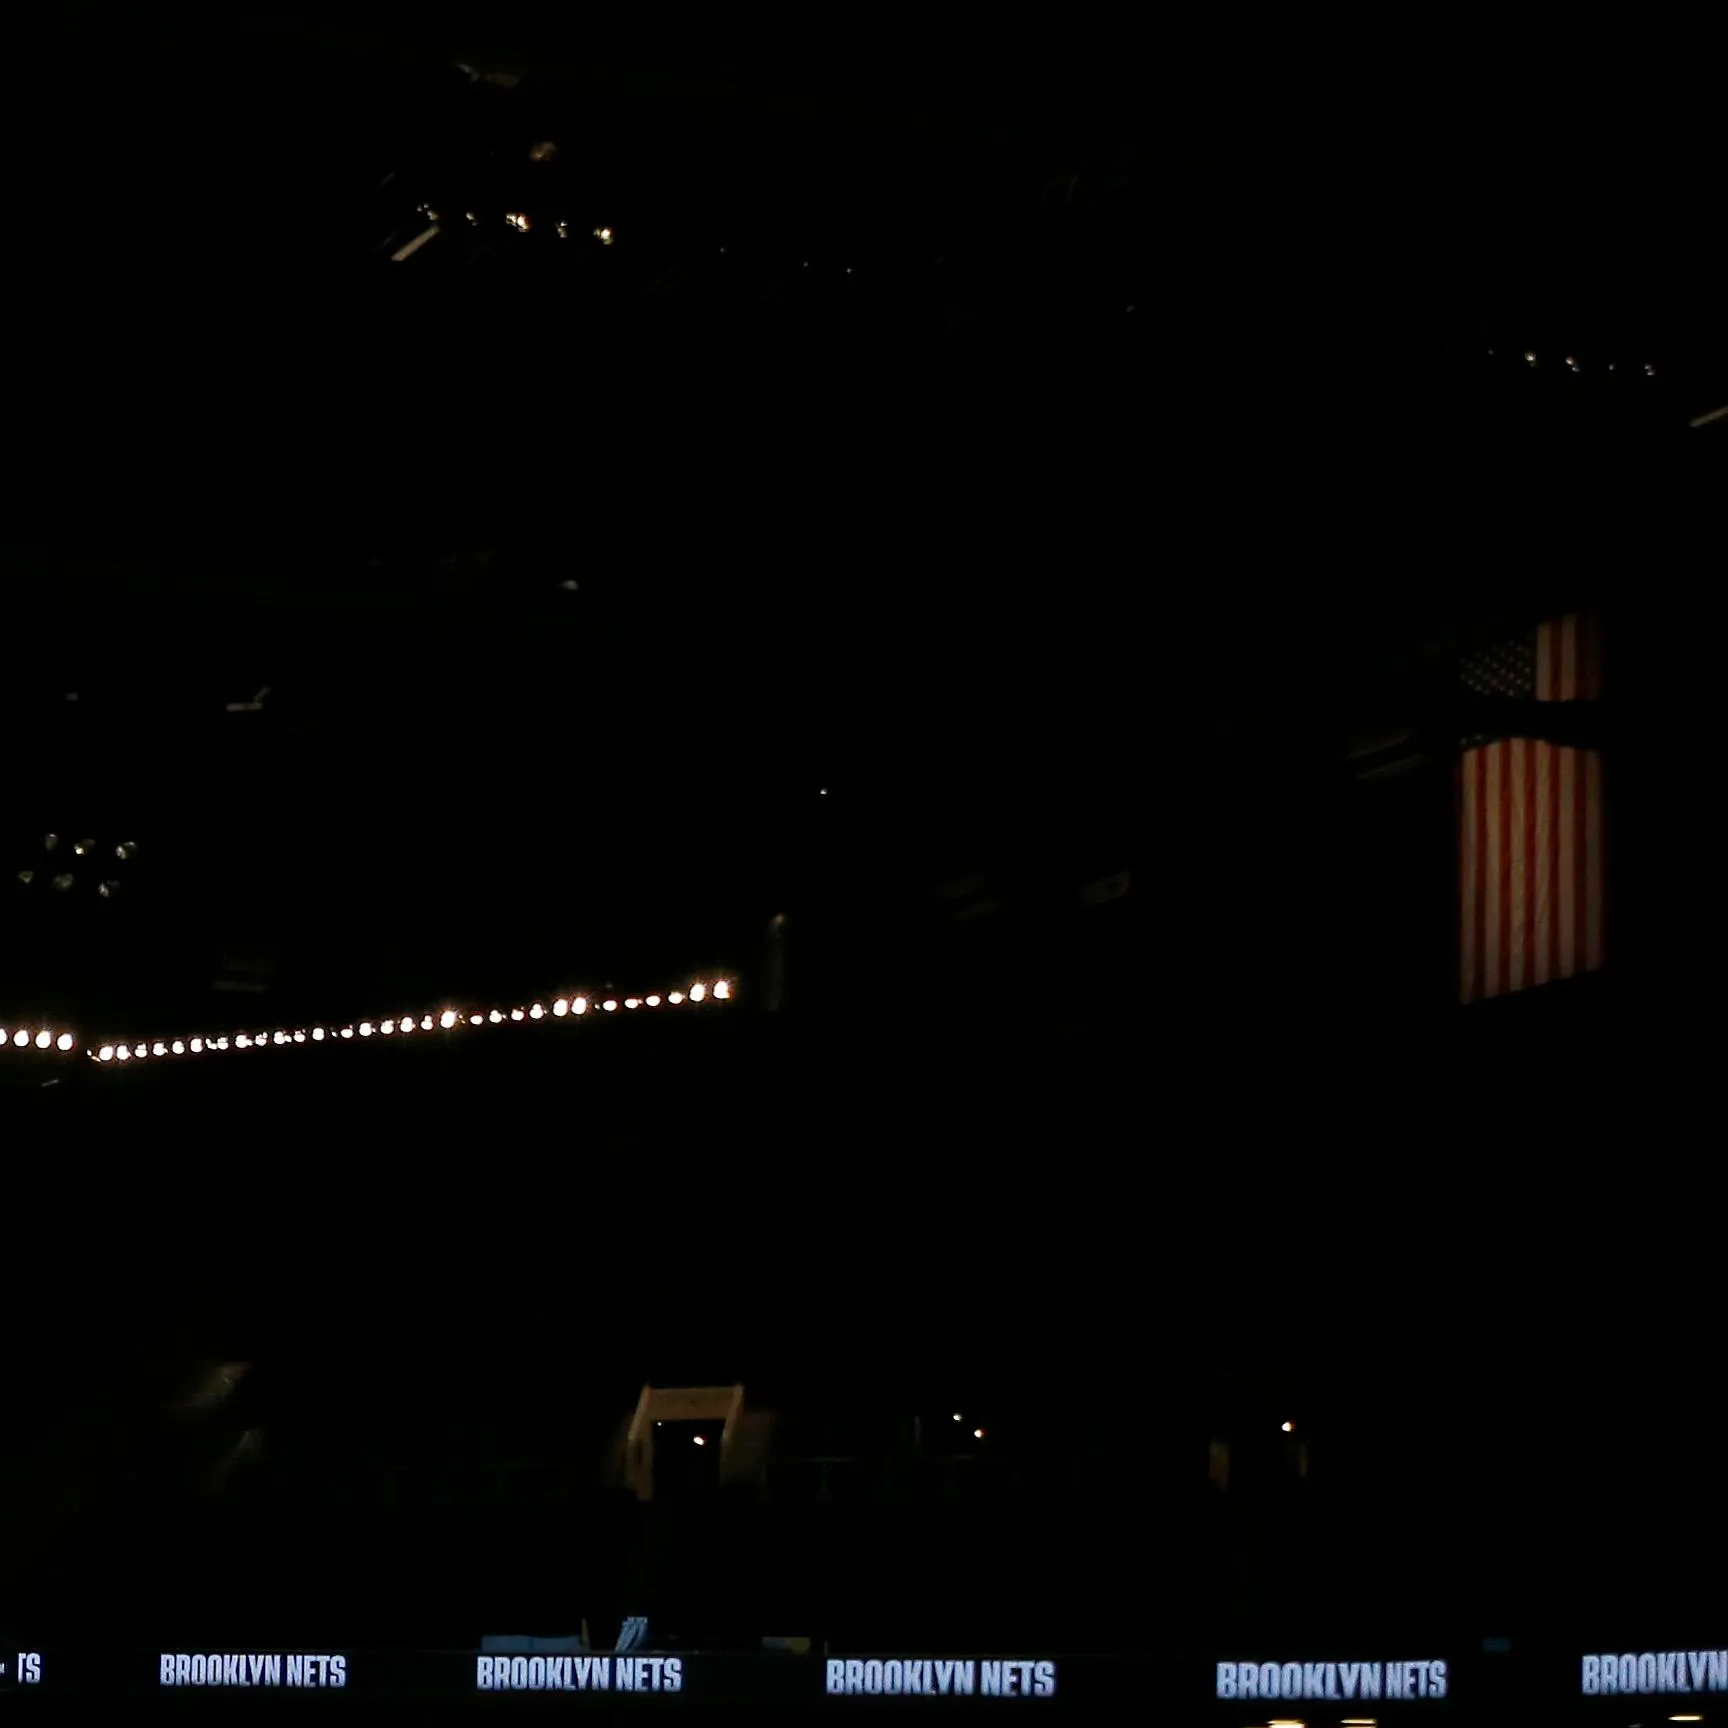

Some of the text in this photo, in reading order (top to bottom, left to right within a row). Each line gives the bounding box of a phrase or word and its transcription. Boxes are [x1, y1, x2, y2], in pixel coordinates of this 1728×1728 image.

[160, 1654, 346, 1687] BROOKLYN NETS
[477, 1656, 682, 1691] BROOKLYN NETS
[827, 1659, 1055, 1696] BROOKLYN NETS
[1217, 1660, 1446, 1699] BROOKLYN NETS
[1582, 1650, 1728, 1694] BROOKLYN
